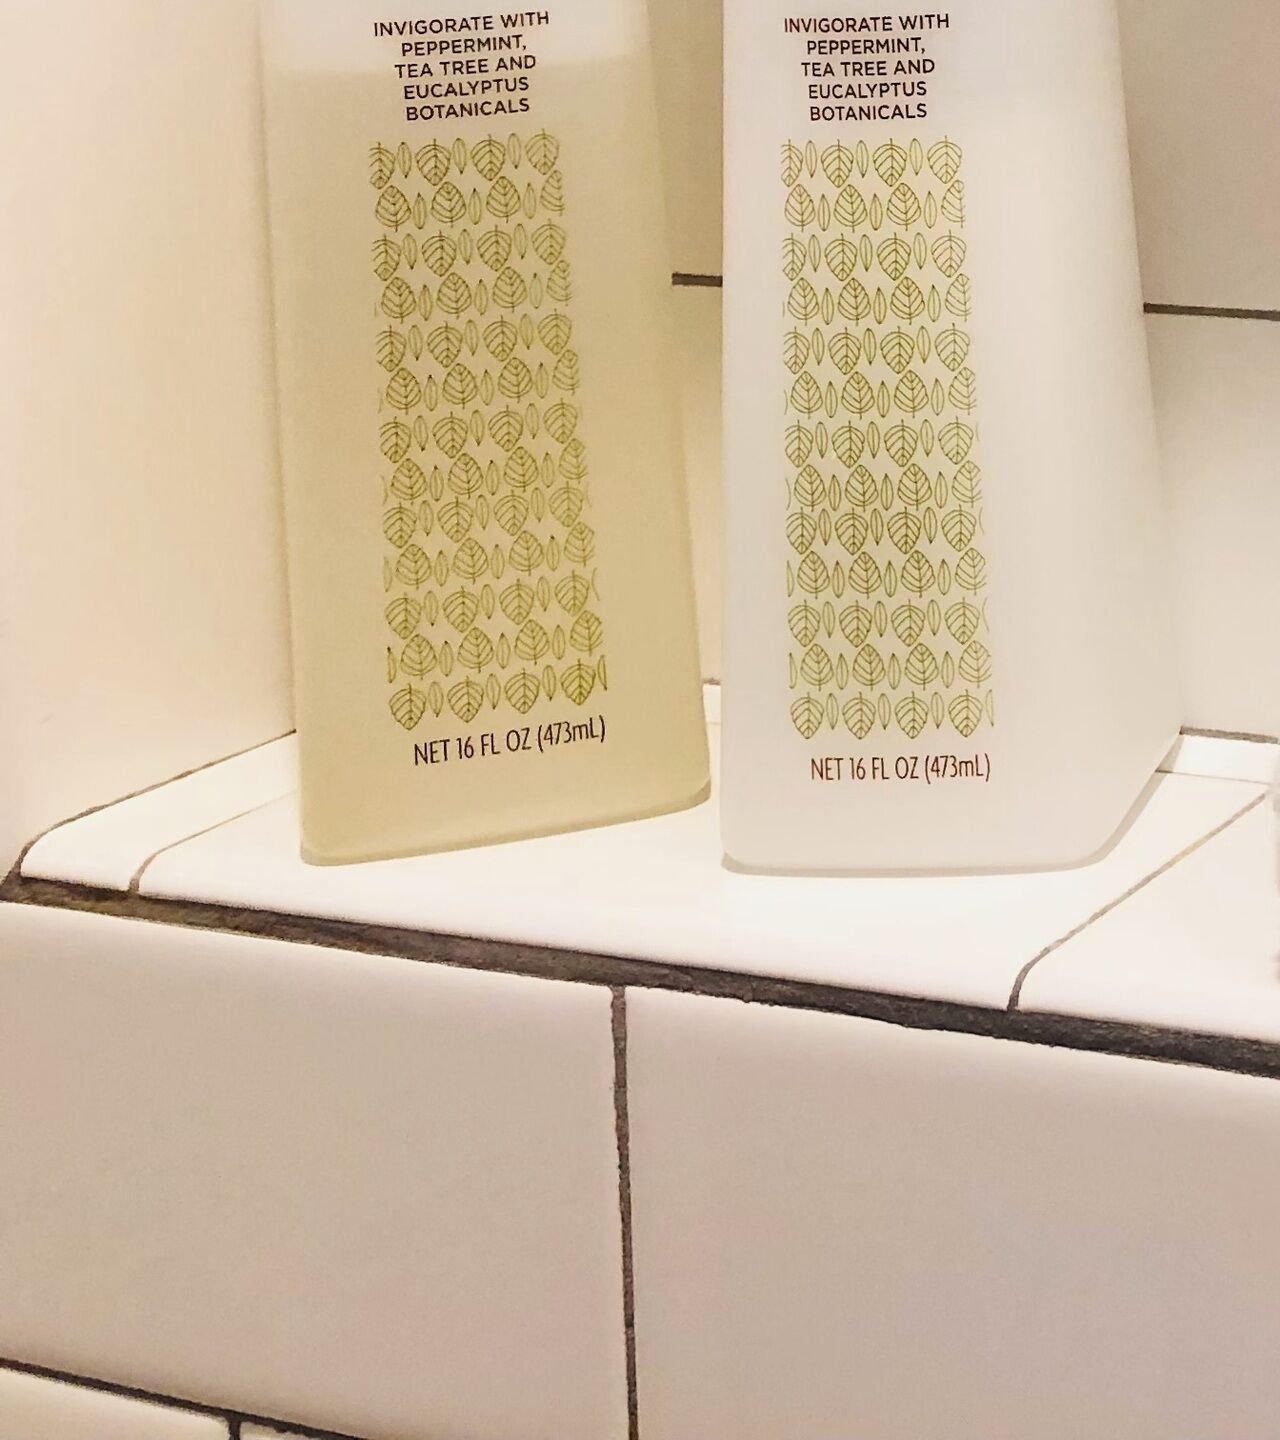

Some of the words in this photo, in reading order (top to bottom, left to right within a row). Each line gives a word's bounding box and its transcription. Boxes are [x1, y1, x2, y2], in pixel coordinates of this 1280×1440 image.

[374, 16, 494, 37] INVIGORATE
[501, 11, 550, 29] WITH
[784, 16, 893, 33] INVIGORATE
[899, 13, 949, 30] WITH
[402, 35, 527, 57] PEPPERMINT,
[807, 37, 926, 55] PEPPERMINT,
[395, 63, 433, 79] TEA
[440, 59, 489, 76] TREE
[495, 55, 536, 72] AND
[801, 62, 835, 77] TEA
[840, 61, 887, 76] TREE
[894, 59, 935, 75] AND
[404, 77, 530, 100] EUCALYPTUS
[808, 81, 927, 99] EUCALYPTUS
[406, 98, 530, 121] BOTANICALS
[810, 103, 927, 121] BOTANICALS
[414, 739, 450, 766] NET
[456, 736, 474, 759] 16
[481, 733, 500, 756] FL
[506, 727, 532, 752] OZ
[538, 715, 606, 753] (473mL)
[811, 758, 843, 780] NET
[849, 758, 866, 780] 16
[872, 757, 890, 780] FL
[895, 756, 919, 779] OZ
[924, 753, 991, 784] (473mL)
